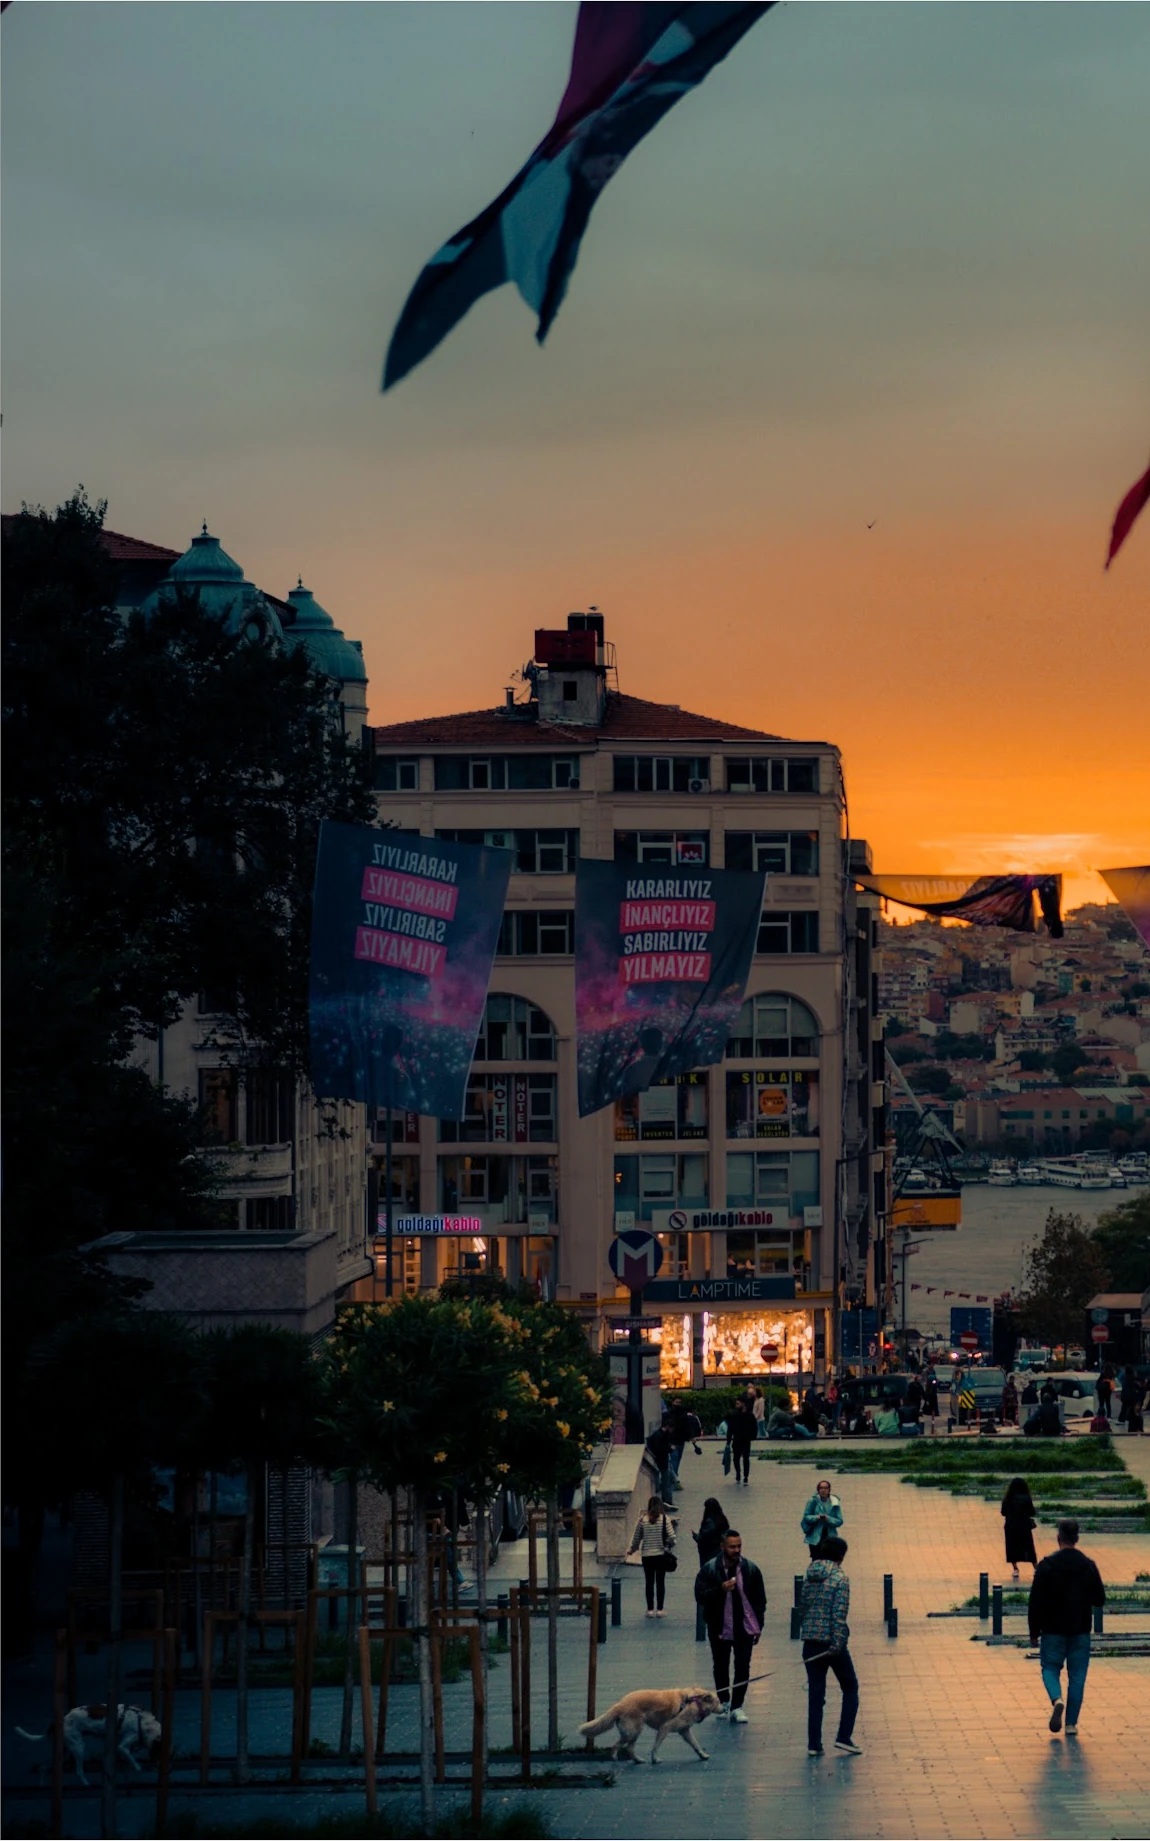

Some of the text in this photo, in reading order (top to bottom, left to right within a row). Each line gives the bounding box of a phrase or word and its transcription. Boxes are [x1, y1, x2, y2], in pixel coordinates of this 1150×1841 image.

[626, 879, 712, 899] KARARLIYIZ
[625, 903, 710, 928] İNANÇLIYIZ
[624, 932, 708, 955] SABIRLIYIZ
[623, 955, 706, 982] YILMAYIZ
[741, 1071, 804, 1084] SOLAR
[494, 1075, 506, 1139] NOTER
[516, 1082, 525, 1133] NOTER
[678, 1281, 762, 1299] LAMPTIME
